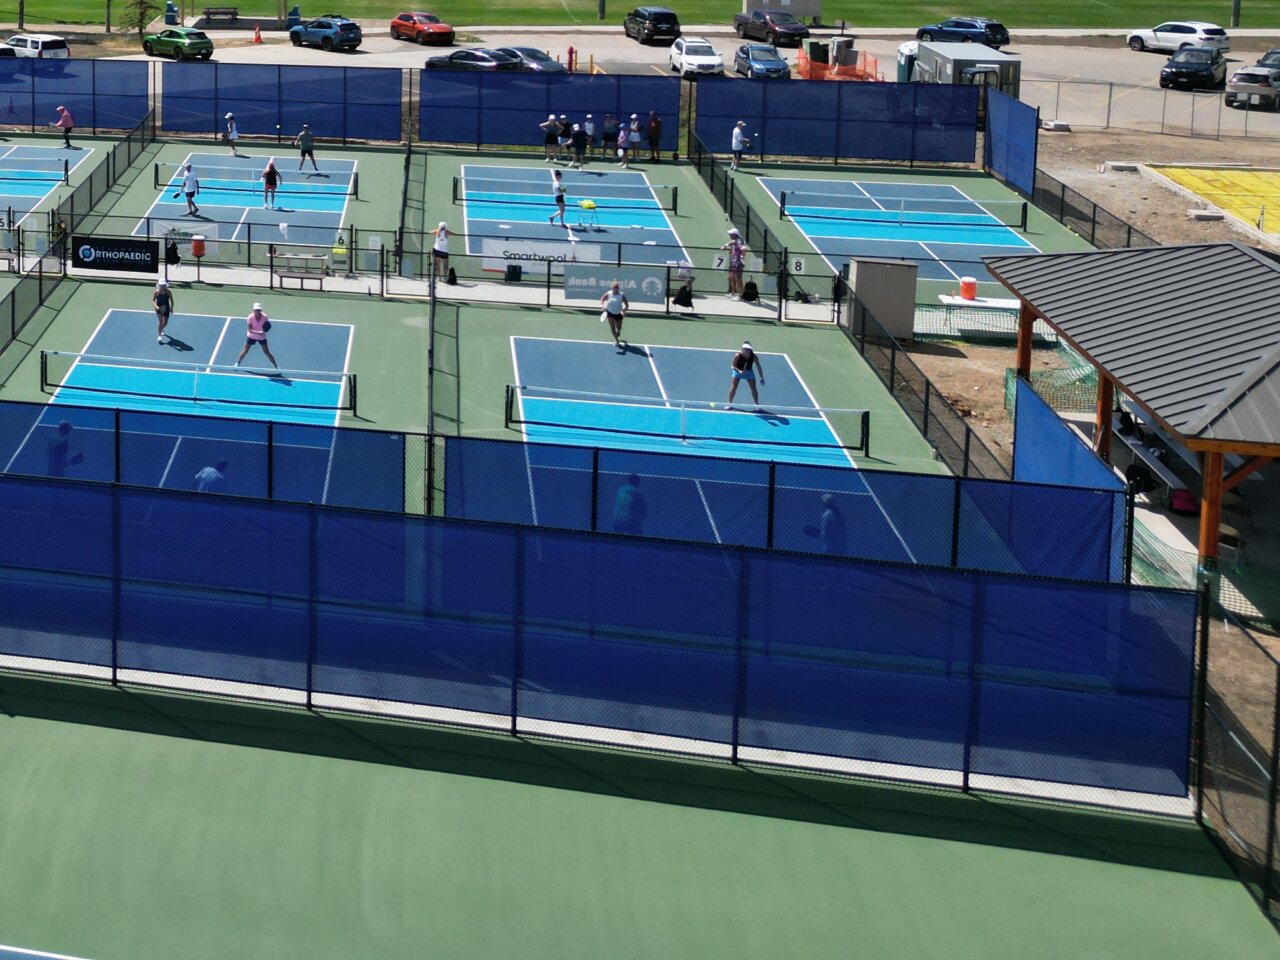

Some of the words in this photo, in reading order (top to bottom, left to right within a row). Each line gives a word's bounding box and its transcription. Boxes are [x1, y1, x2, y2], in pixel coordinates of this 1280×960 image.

[0, 218, 5, 227] 5
[338, 236, 344, 244] 6
[503, 250, 566, 262] Smartwool
[717, 258, 724, 267] 7
[795, 262, 802, 271] 8
